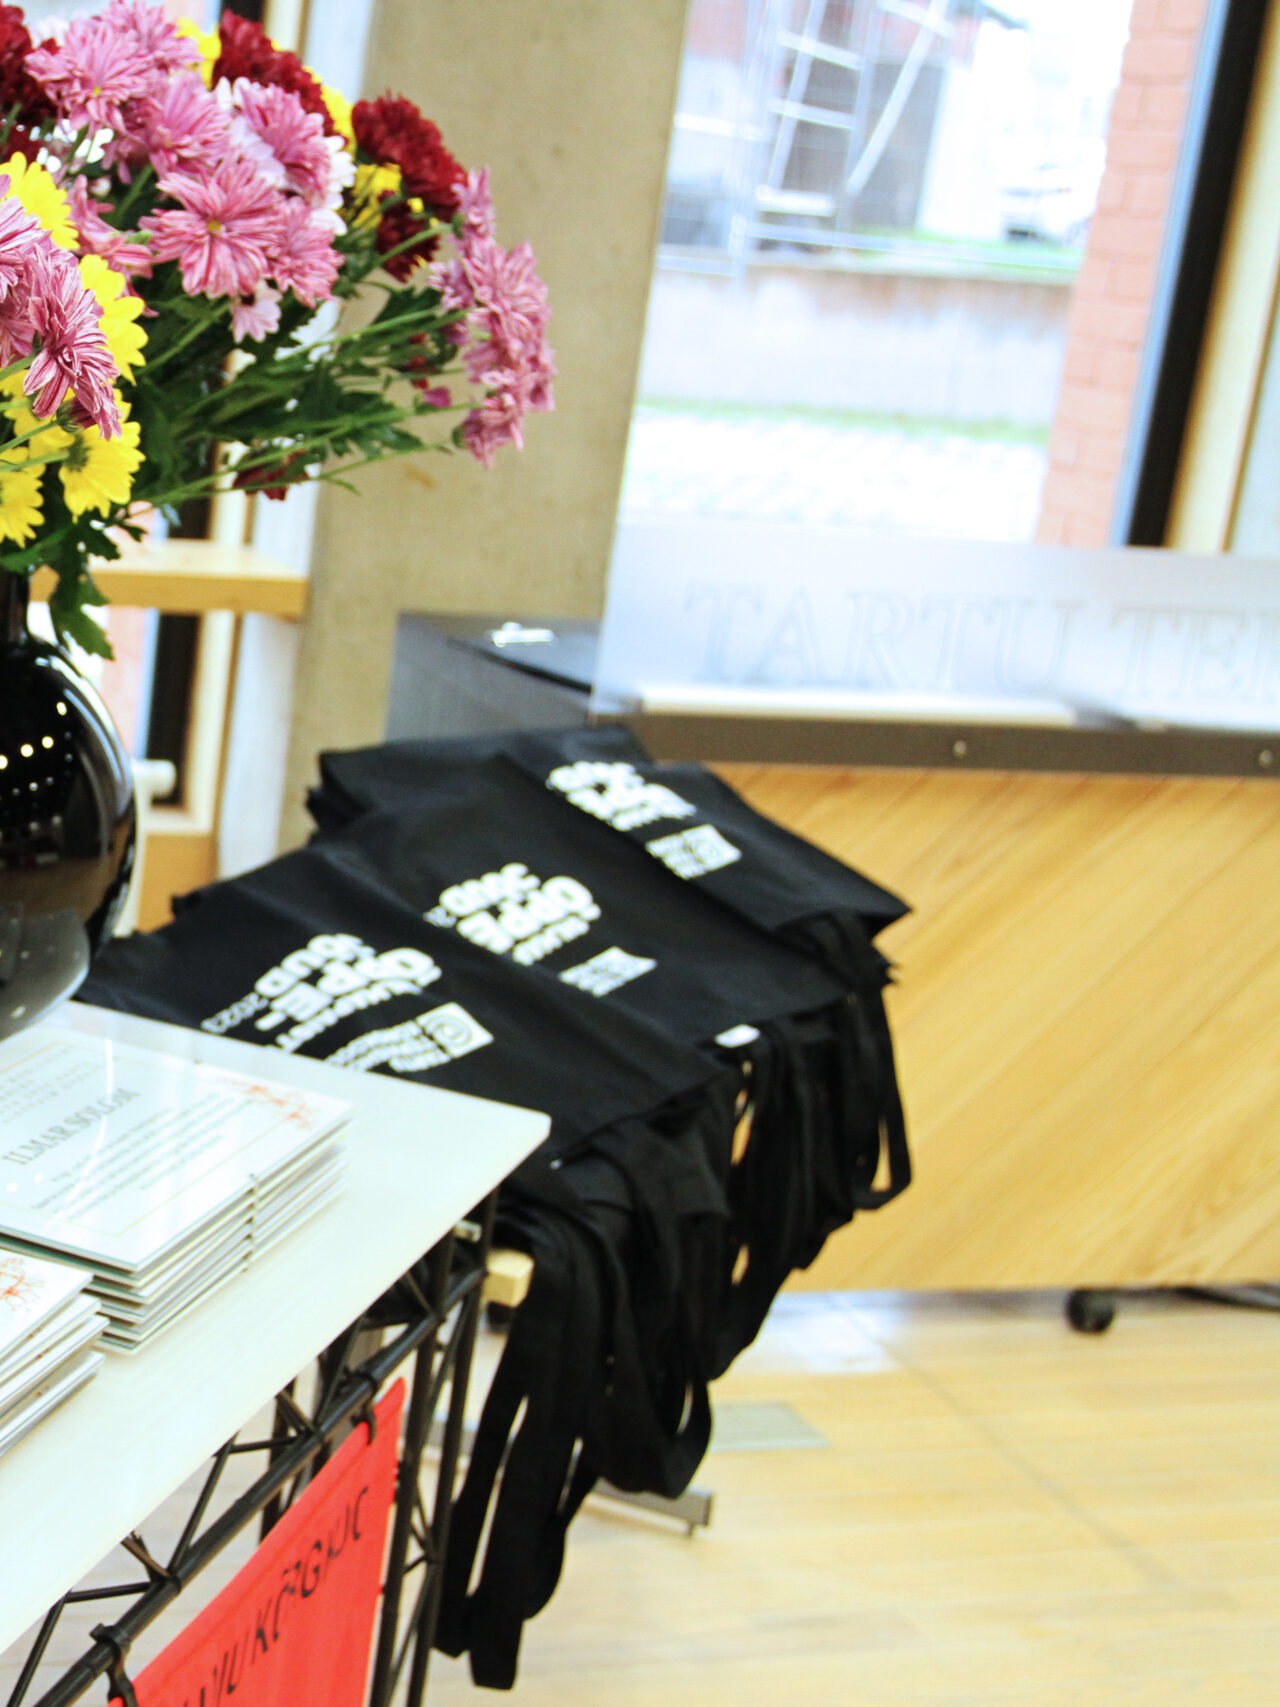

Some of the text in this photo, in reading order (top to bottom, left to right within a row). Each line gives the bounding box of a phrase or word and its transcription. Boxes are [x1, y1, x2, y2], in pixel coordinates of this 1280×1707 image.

[682, 580, 1090, 696] TARTU
[200, 991, 269, 1035] 2023
[2, 1126, 76, 1164] ILMAR
